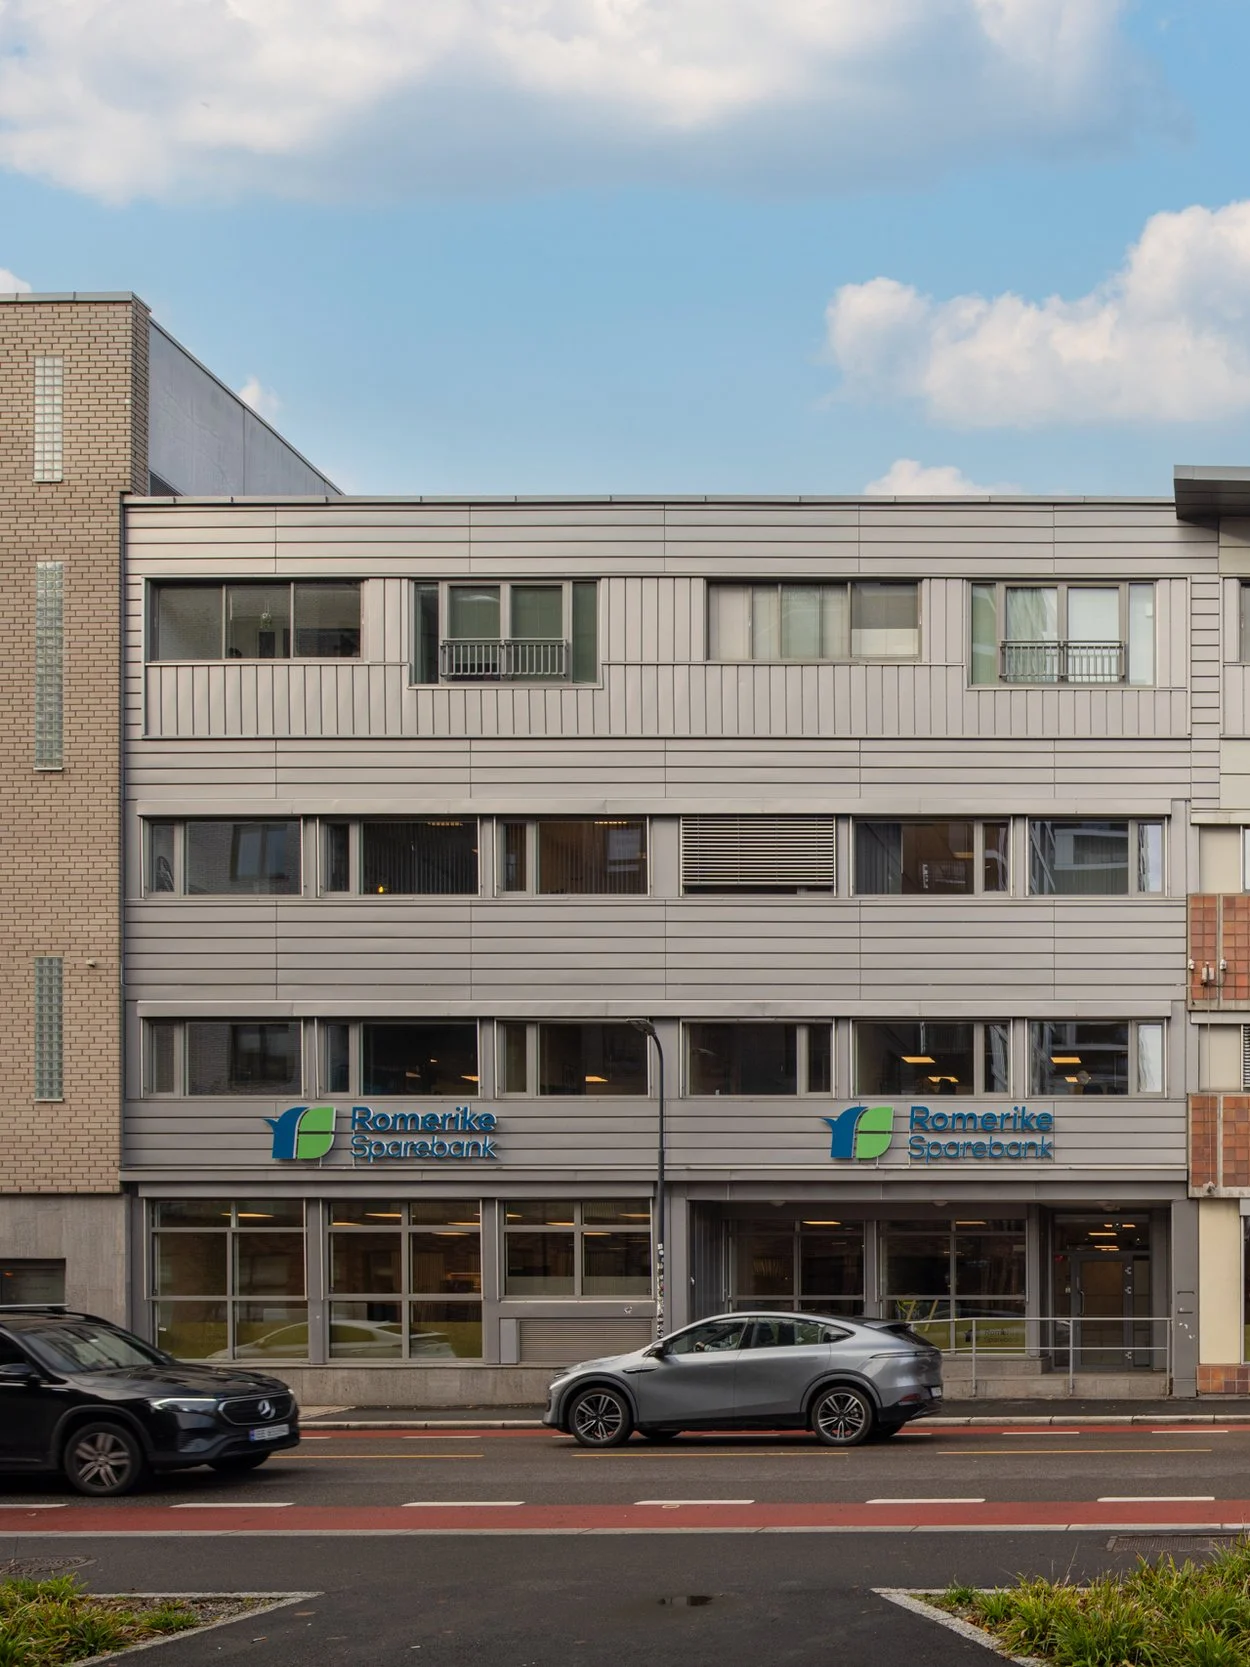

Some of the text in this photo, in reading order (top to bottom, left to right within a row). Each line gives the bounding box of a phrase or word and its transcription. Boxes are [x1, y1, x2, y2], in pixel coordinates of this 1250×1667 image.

[351, 1106, 498, 1132] Romerike
[909, 1106, 1054, 1132] Romerike
[351, 1135, 498, 1163] Sparebank
[908, 1135, 1053, 1164] Sparebank
